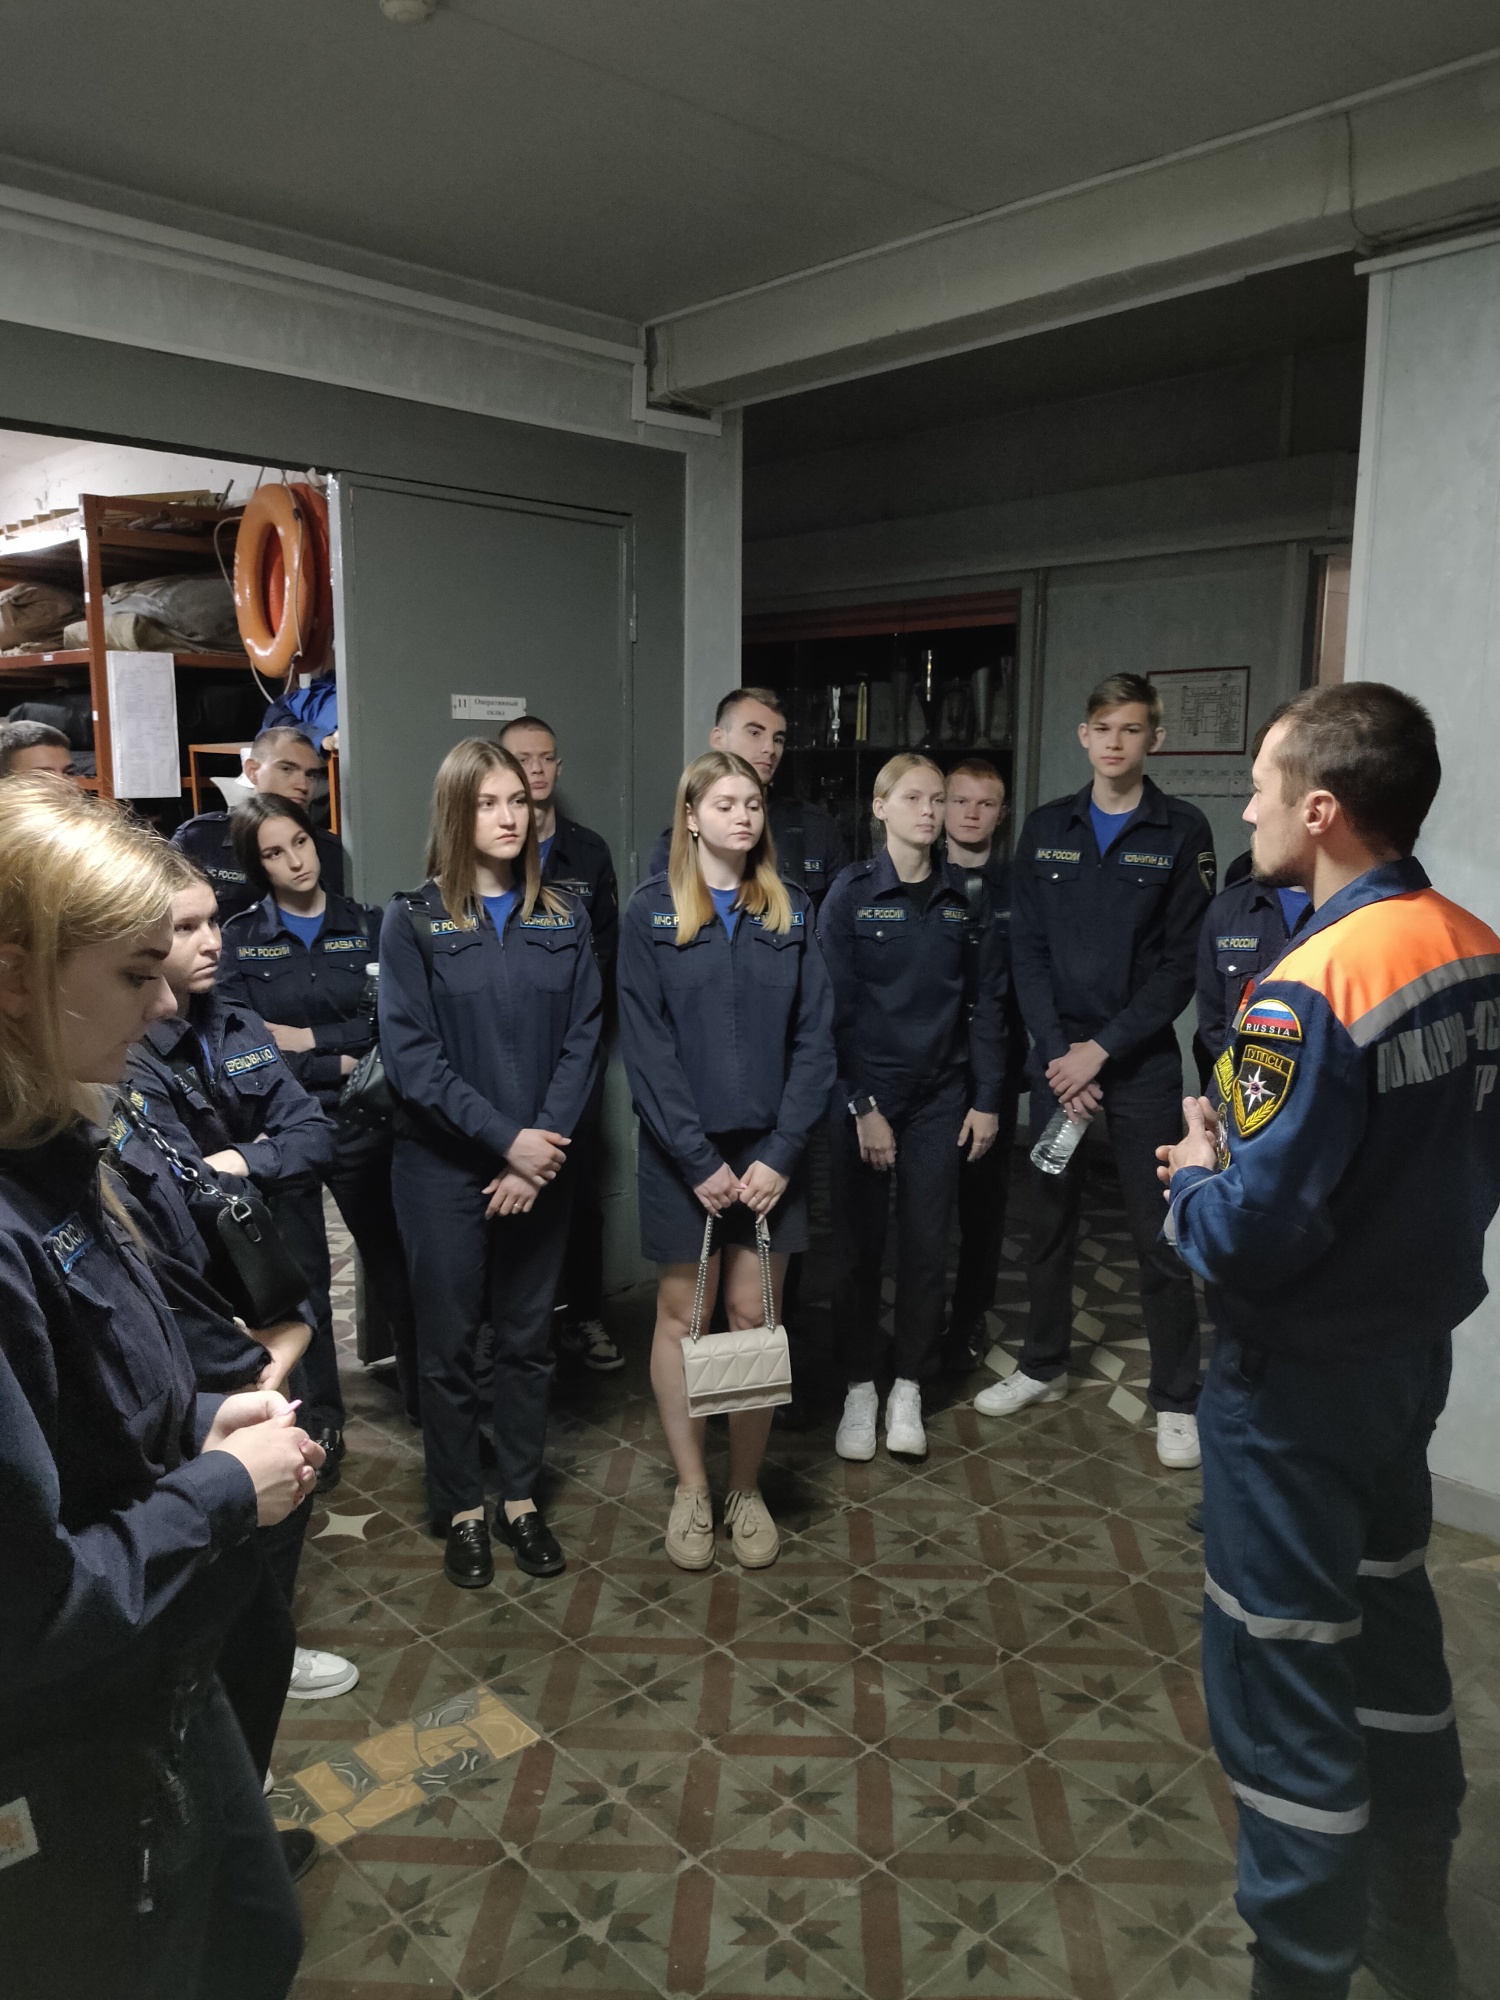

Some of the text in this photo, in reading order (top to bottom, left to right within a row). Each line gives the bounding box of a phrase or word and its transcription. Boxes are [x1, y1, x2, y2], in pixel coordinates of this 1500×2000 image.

[458, 698, 467, 708] 11
[474, 698, 518, 706] Оперативный
[1052, 850, 1080, 861] РОССИИ
[217, 870, 246, 881] РОССИИ
[653, 914, 672, 925] МЧС
[873, 909, 903, 919] РОССИИ
[239, 946, 289, 957] МЧС РОССИИ
[1246, 1023, 1290, 1036] RUSSIA
